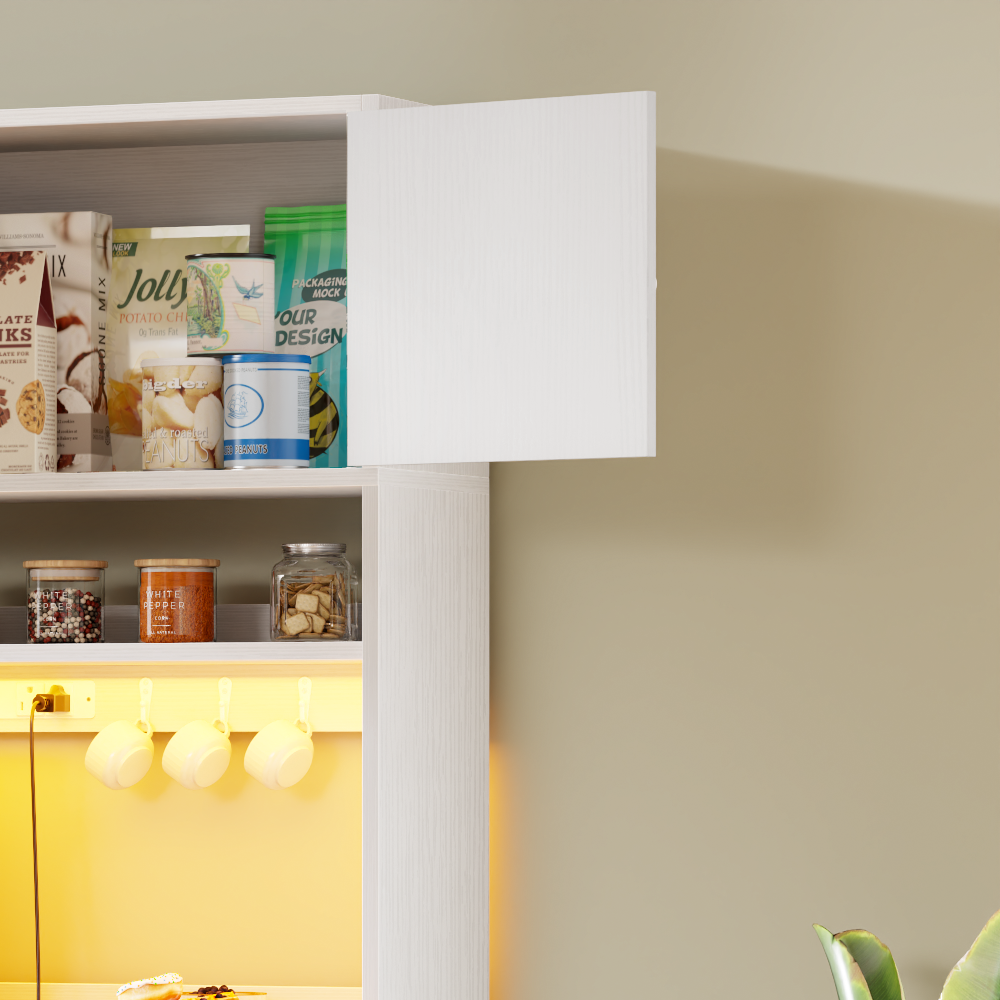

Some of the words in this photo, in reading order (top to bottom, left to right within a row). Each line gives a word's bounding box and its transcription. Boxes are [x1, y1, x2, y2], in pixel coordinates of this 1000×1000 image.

[112, 243, 133, 251] NEW
[51, 254, 67, 278] IX
[98, 276, 107, 312] MIX
[312, 288, 341, 298] MOCK
[119, 312, 163, 324] POTATO
[166, 311, 188, 323] CHI
[148, 328, 166, 337] Trans
[168, 327, 179, 336] Fat
[160, 426, 168, 439] &
[170, 426, 209, 439] roasted
[234, 443, 269, 455] PEANUTS
[146, 590, 181, 599] WHITE
[31, 602, 73, 611] PEPPER
[143, 601, 185, 610] PEPPER
